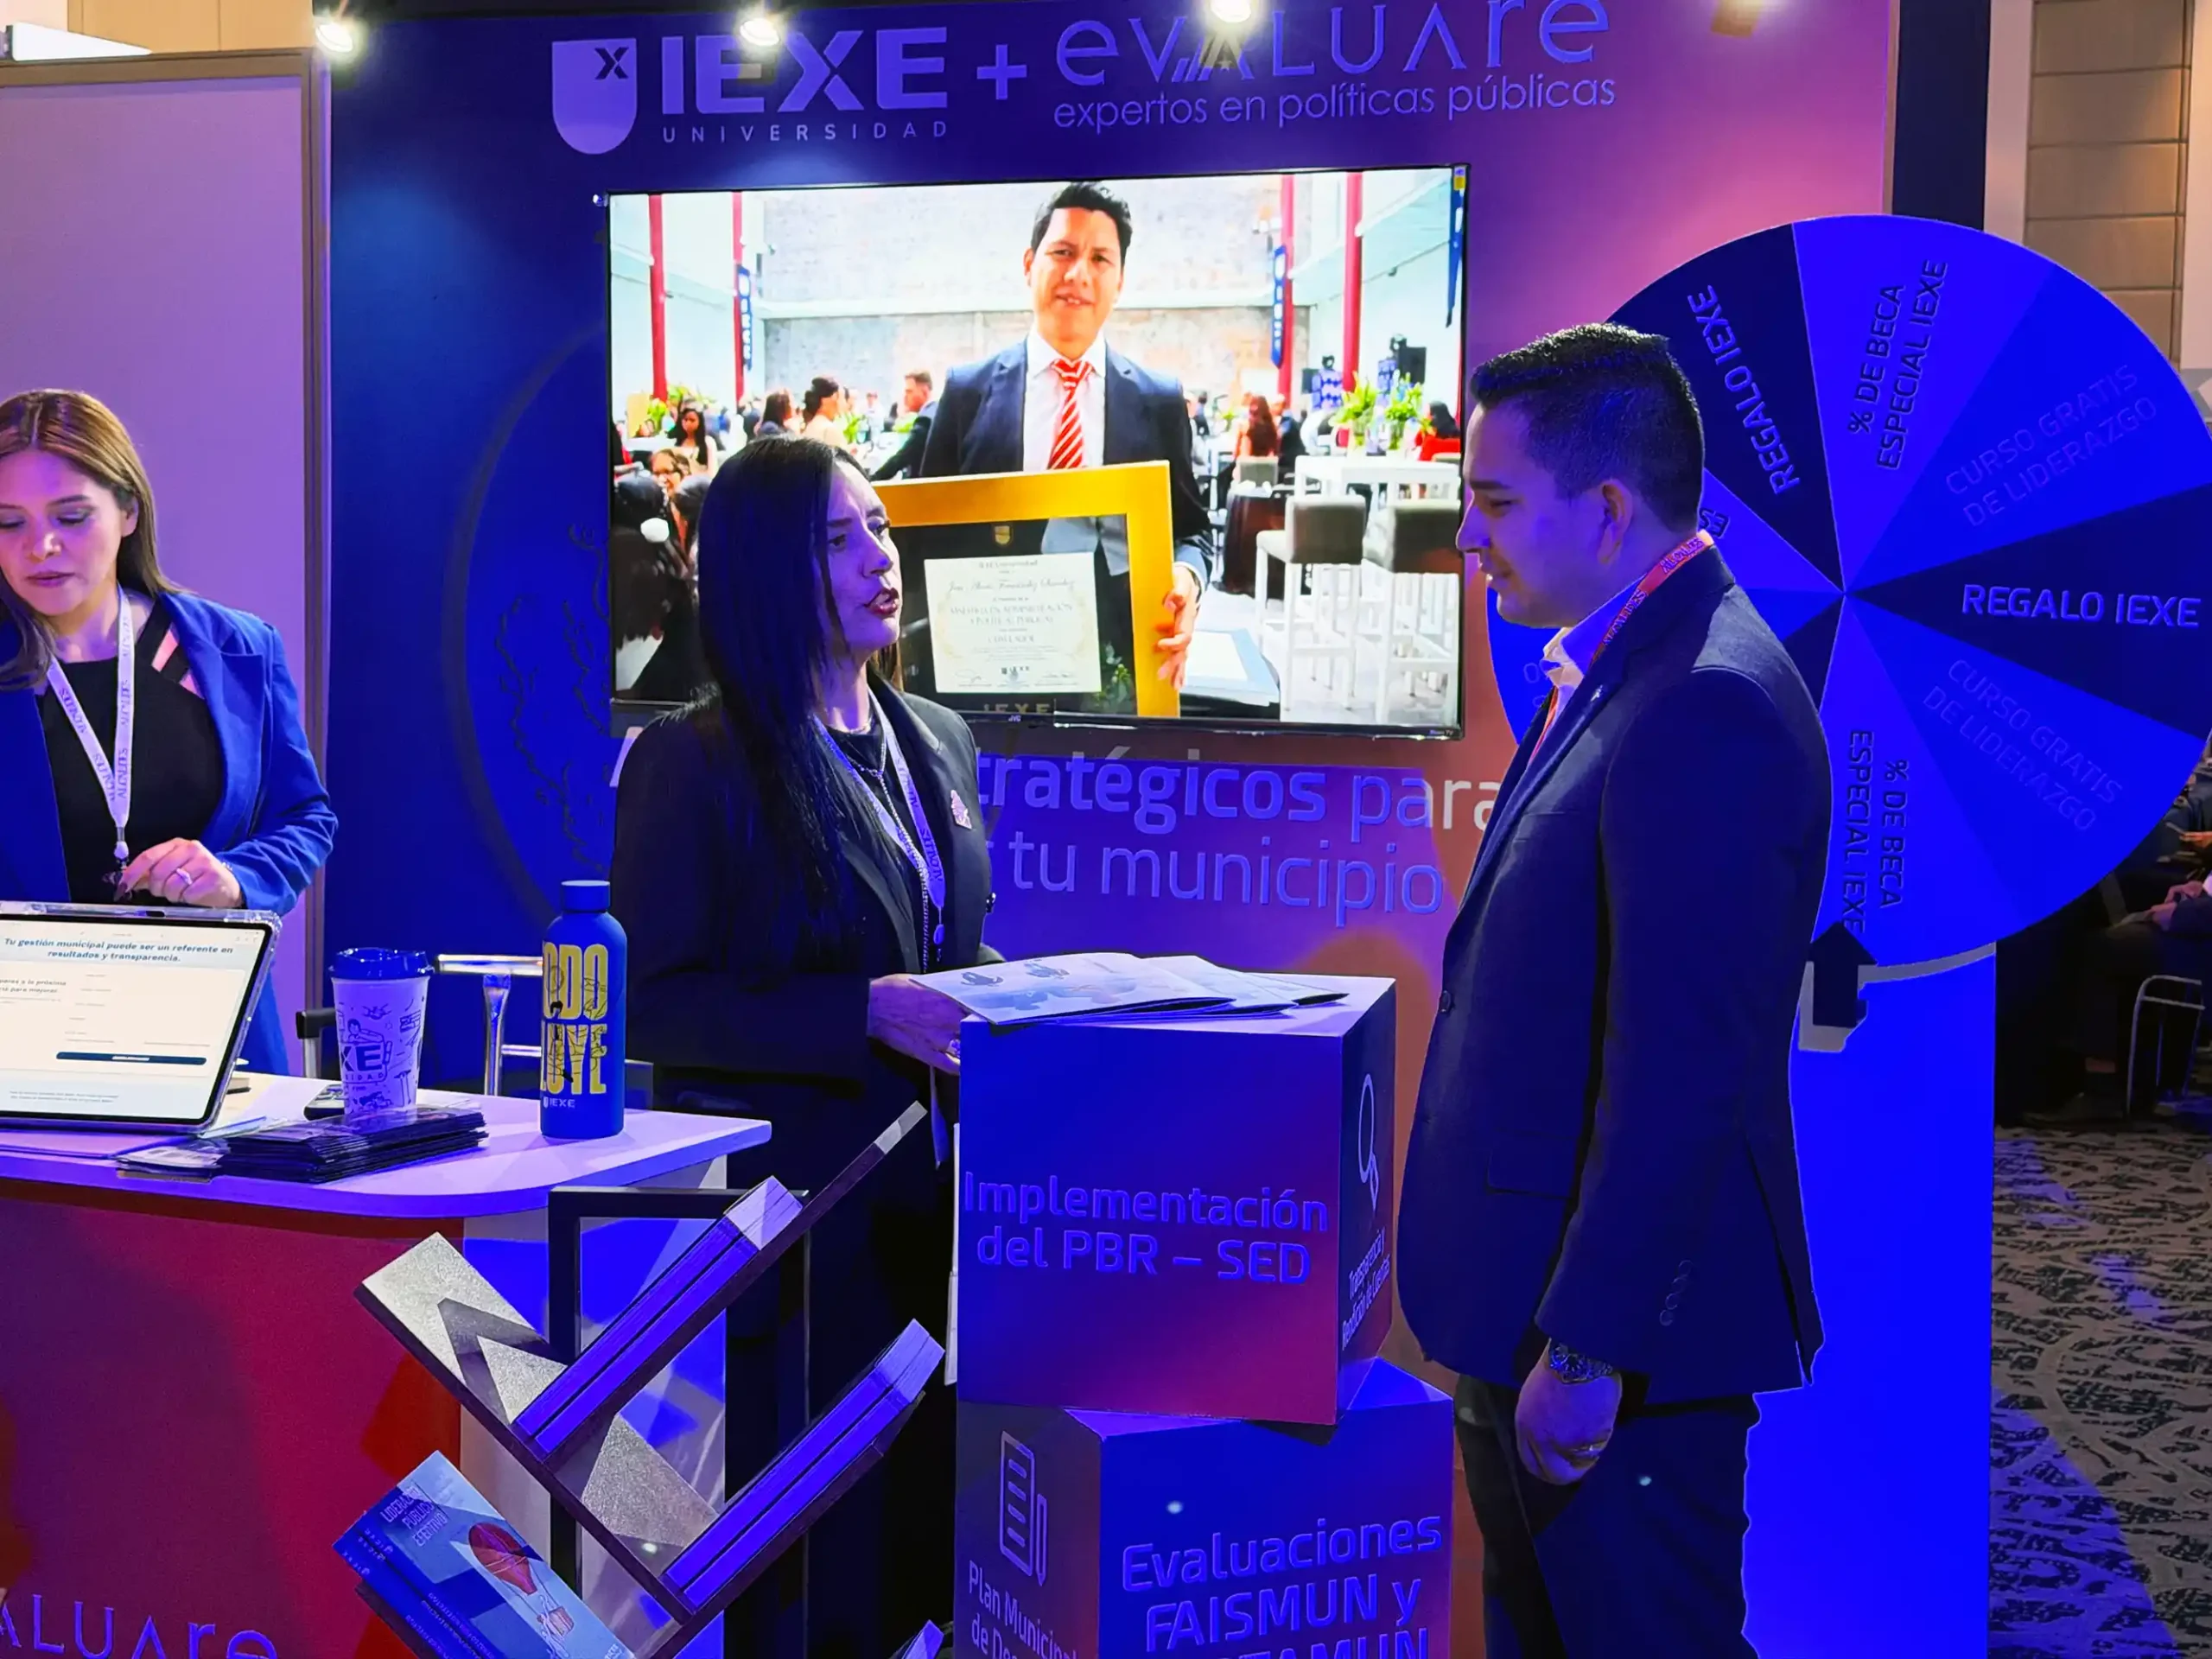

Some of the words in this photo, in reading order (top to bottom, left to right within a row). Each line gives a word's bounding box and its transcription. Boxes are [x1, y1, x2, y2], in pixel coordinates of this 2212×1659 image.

[662, 27, 949, 115] IEXE
[1053, 92, 1207, 135] expertos
[1219, 98, 1267, 123] en
[1279, 79, 1434, 127] políticas
[1448, 71, 1617, 121] públicas
[662, 121, 948, 143] UNIVERSIDAD
[1687, 284, 1736, 366] IEXE
[1866, 283, 1906, 358] BECA
[1855, 362, 1886, 406] DE
[1877, 343, 1929, 470] ESPECIAL
[1911, 259, 1948, 330] IEXE
[1723, 365, 1801, 495] REGALO
[1945, 422, 2037, 495] CURSO
[2035, 365, 2139, 440] GRATIS
[1962, 489, 2005, 527] DE
[2003, 396, 2158, 504] LIDERAZGO
[1961, 584, 2105, 621] REGALO
[2114, 594, 2202, 628] IEXE
[1923, 686, 1963, 725] DE
[1958, 713, 2097, 831] LIDERAZGO
[1947, 658, 2032, 732] CURSO
[2030, 722, 2124, 804] GRATIS
[1843, 728, 1874, 868] ESPECIAL
[1883, 791, 1908, 830] DE
[1008, 831, 1077, 893] tu
[1101, 836, 1445, 927] municipio
[1840, 870, 1868, 934] IEXE
[1879, 836, 1907, 912] BECA
[4, 938, 16, 946] Tu
[17, 938, 54, 948] gestión
[56, 939, 105, 950] municipal
[106, 941, 138, 950] puede
[172, 944, 219, 953] referente
[48, 950, 99, 959] resultados
[111, 951, 181, 963] transparencia.
[964, 1170, 1328, 1233] Implementación
[976, 1225, 1049, 1268] del
[1063, 1230, 1158, 1277] PBR
[1217, 1239, 1312, 1284] SED
[969, 1559, 1001, 1620] Plan
[1122, 1515, 1443, 1593] Evaluaciones
[971, 1611, 988, 1656] de
[1146, 1573, 1378, 1653] FAISMUN
[1390, 1578, 1422, 1627] y
